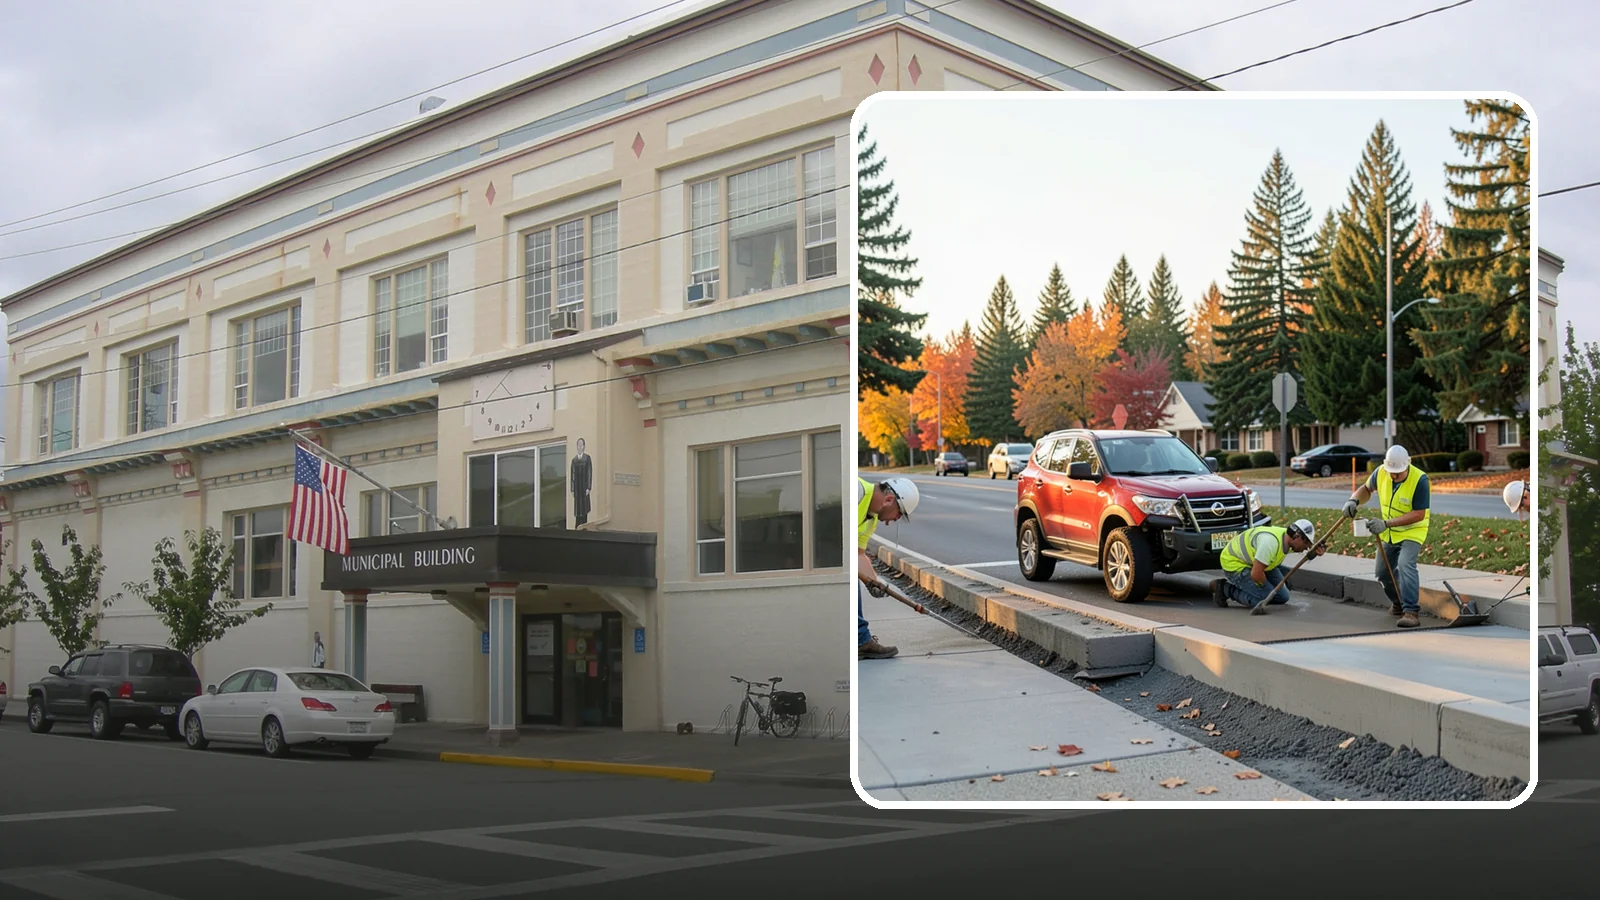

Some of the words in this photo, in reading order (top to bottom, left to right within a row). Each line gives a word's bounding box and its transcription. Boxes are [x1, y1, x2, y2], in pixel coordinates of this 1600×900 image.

[546, 362, 552, 370] 6
[475, 390, 479, 398] 7
[536, 402, 540, 410] 4
[480, 406, 485, 415] 8
[487, 417, 493, 426] 9
[529, 414, 533, 422] 3
[494, 423, 500, 432] 10
[521, 420, 526, 428] 2
[501, 425, 506, 434] 11
[507, 425, 513, 433] 12
[342, 552, 405, 572] MUNICIPAL
[414, 546, 475, 567] BUILDING
